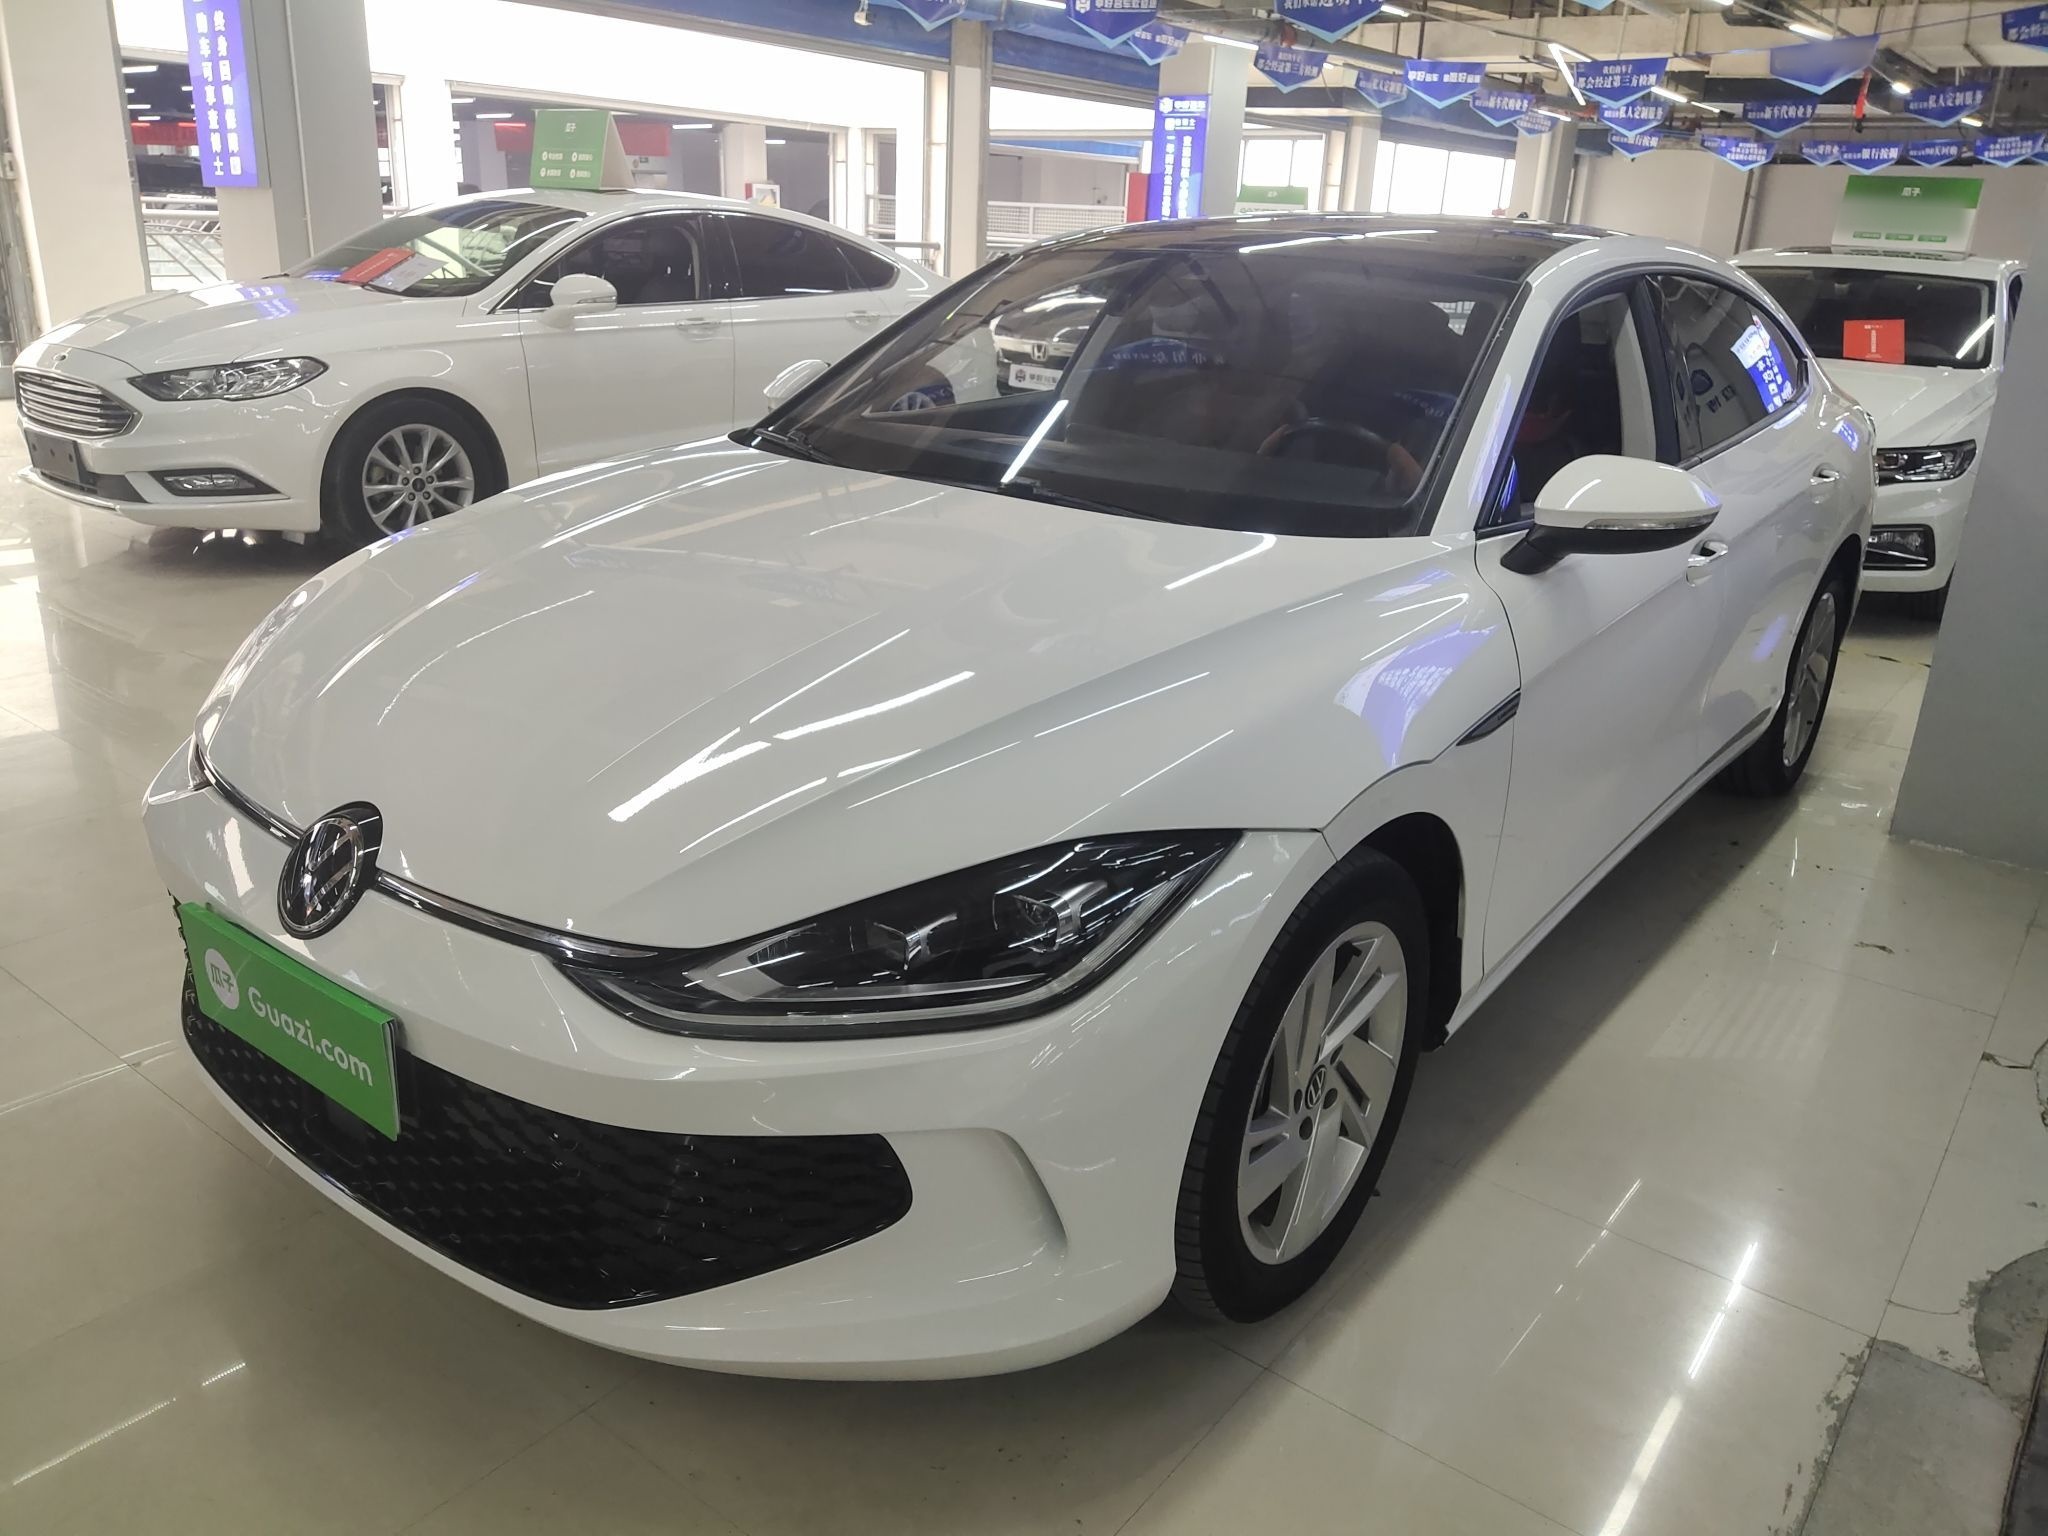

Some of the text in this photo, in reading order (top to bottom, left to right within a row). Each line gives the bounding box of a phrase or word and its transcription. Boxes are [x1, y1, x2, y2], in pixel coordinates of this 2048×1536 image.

[1901, 187, 1921, 197] 瓜子
[210, 963, 235, 993] 瓜子
[248, 986, 373, 1087] Guazi.com
